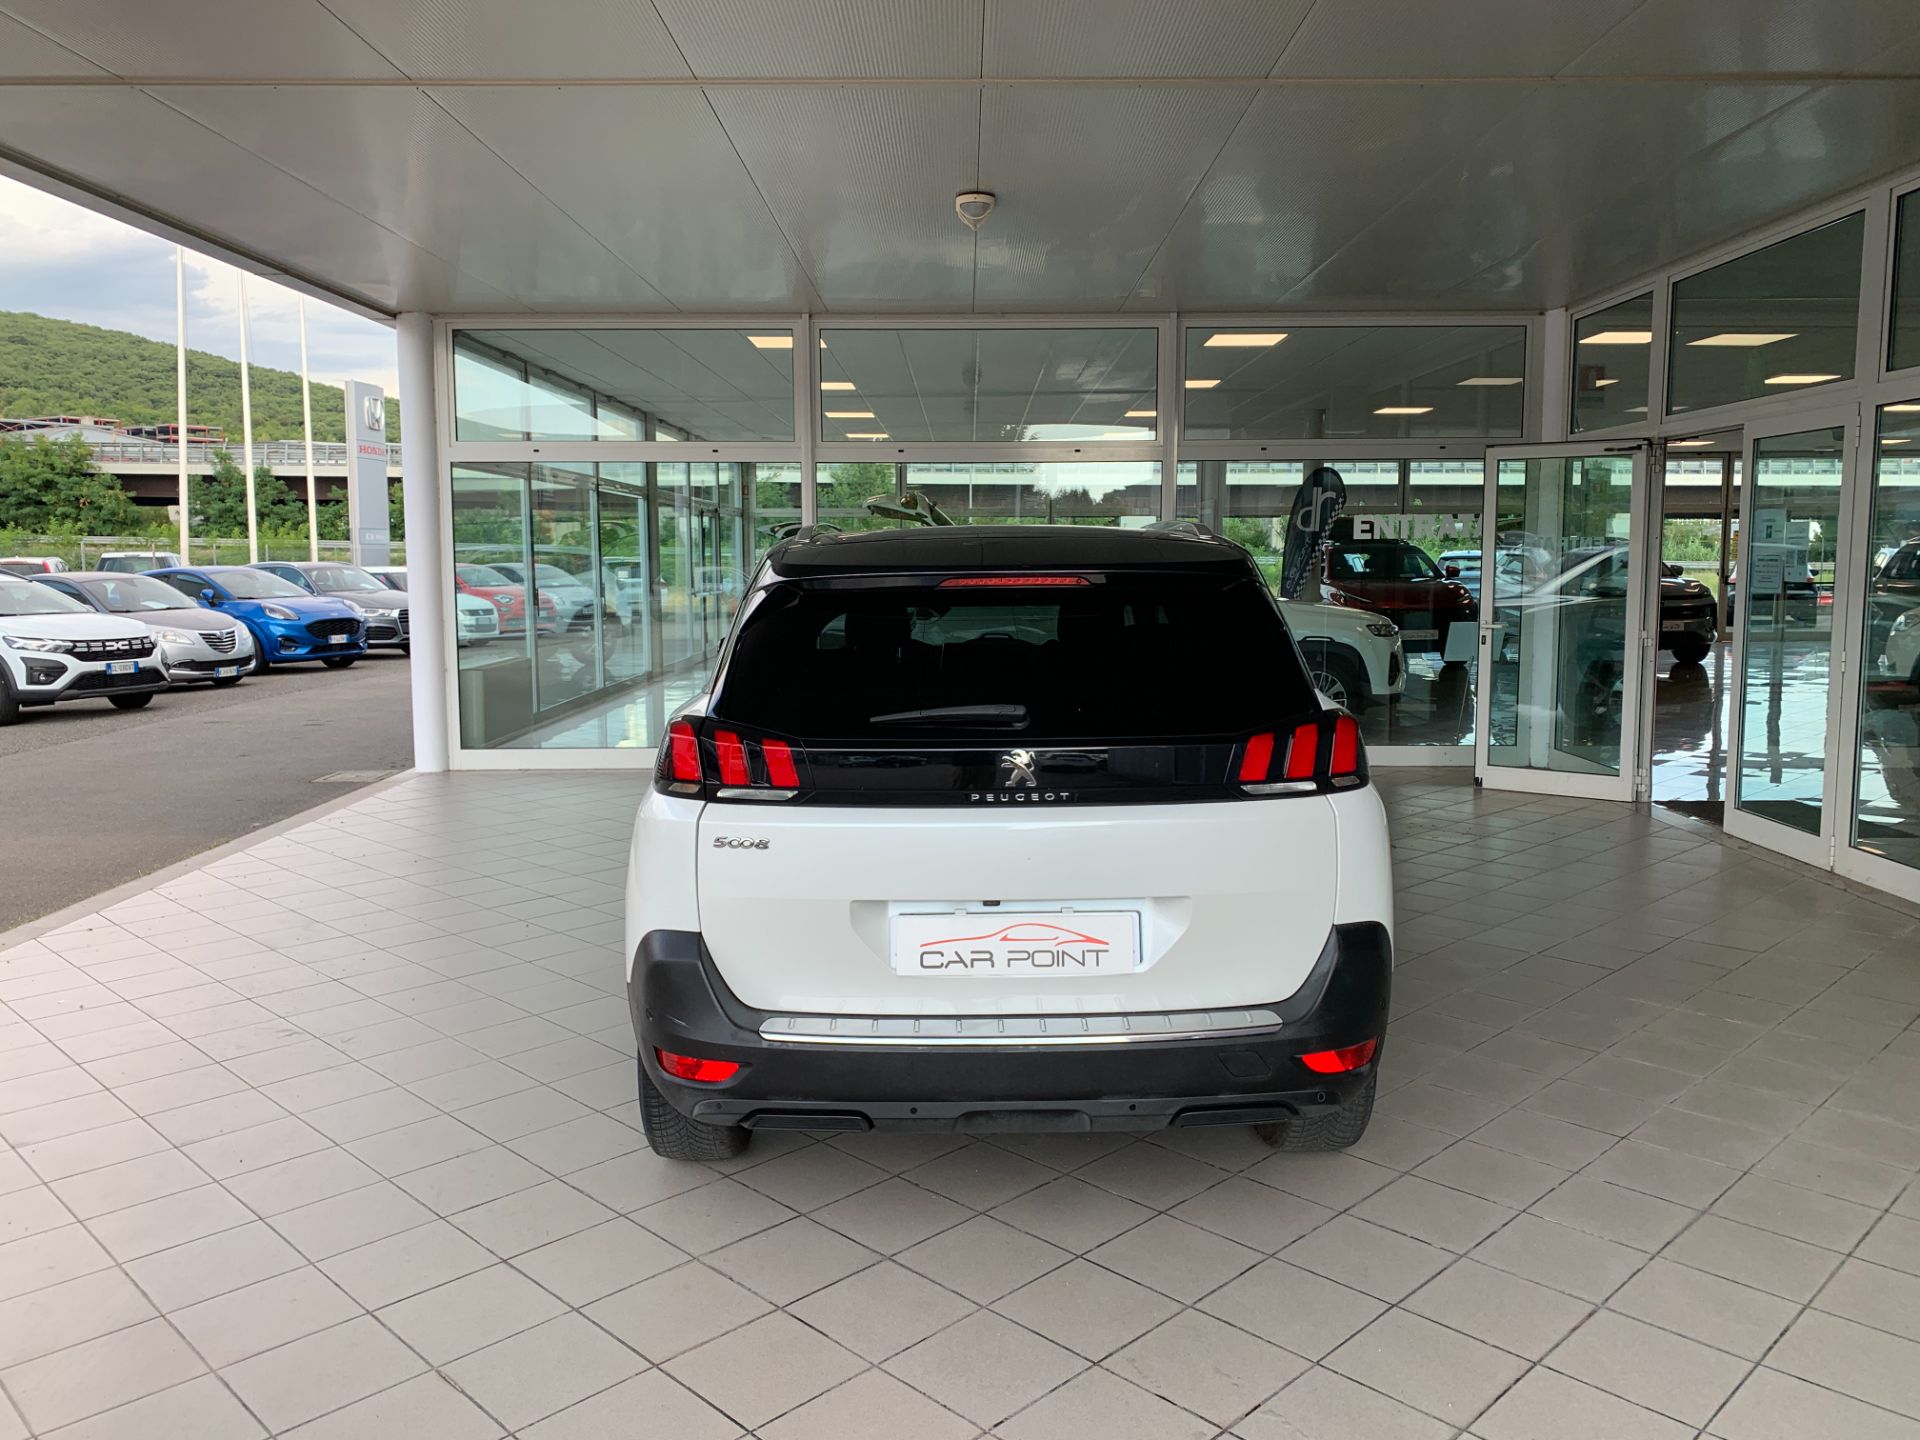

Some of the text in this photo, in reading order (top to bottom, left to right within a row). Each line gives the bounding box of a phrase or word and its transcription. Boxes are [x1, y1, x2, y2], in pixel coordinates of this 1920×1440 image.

[970, 792, 1070, 802] PEUGEOT
[712, 836, 770, 850] 5008
[920, 949, 1110, 969] CAR POINT
